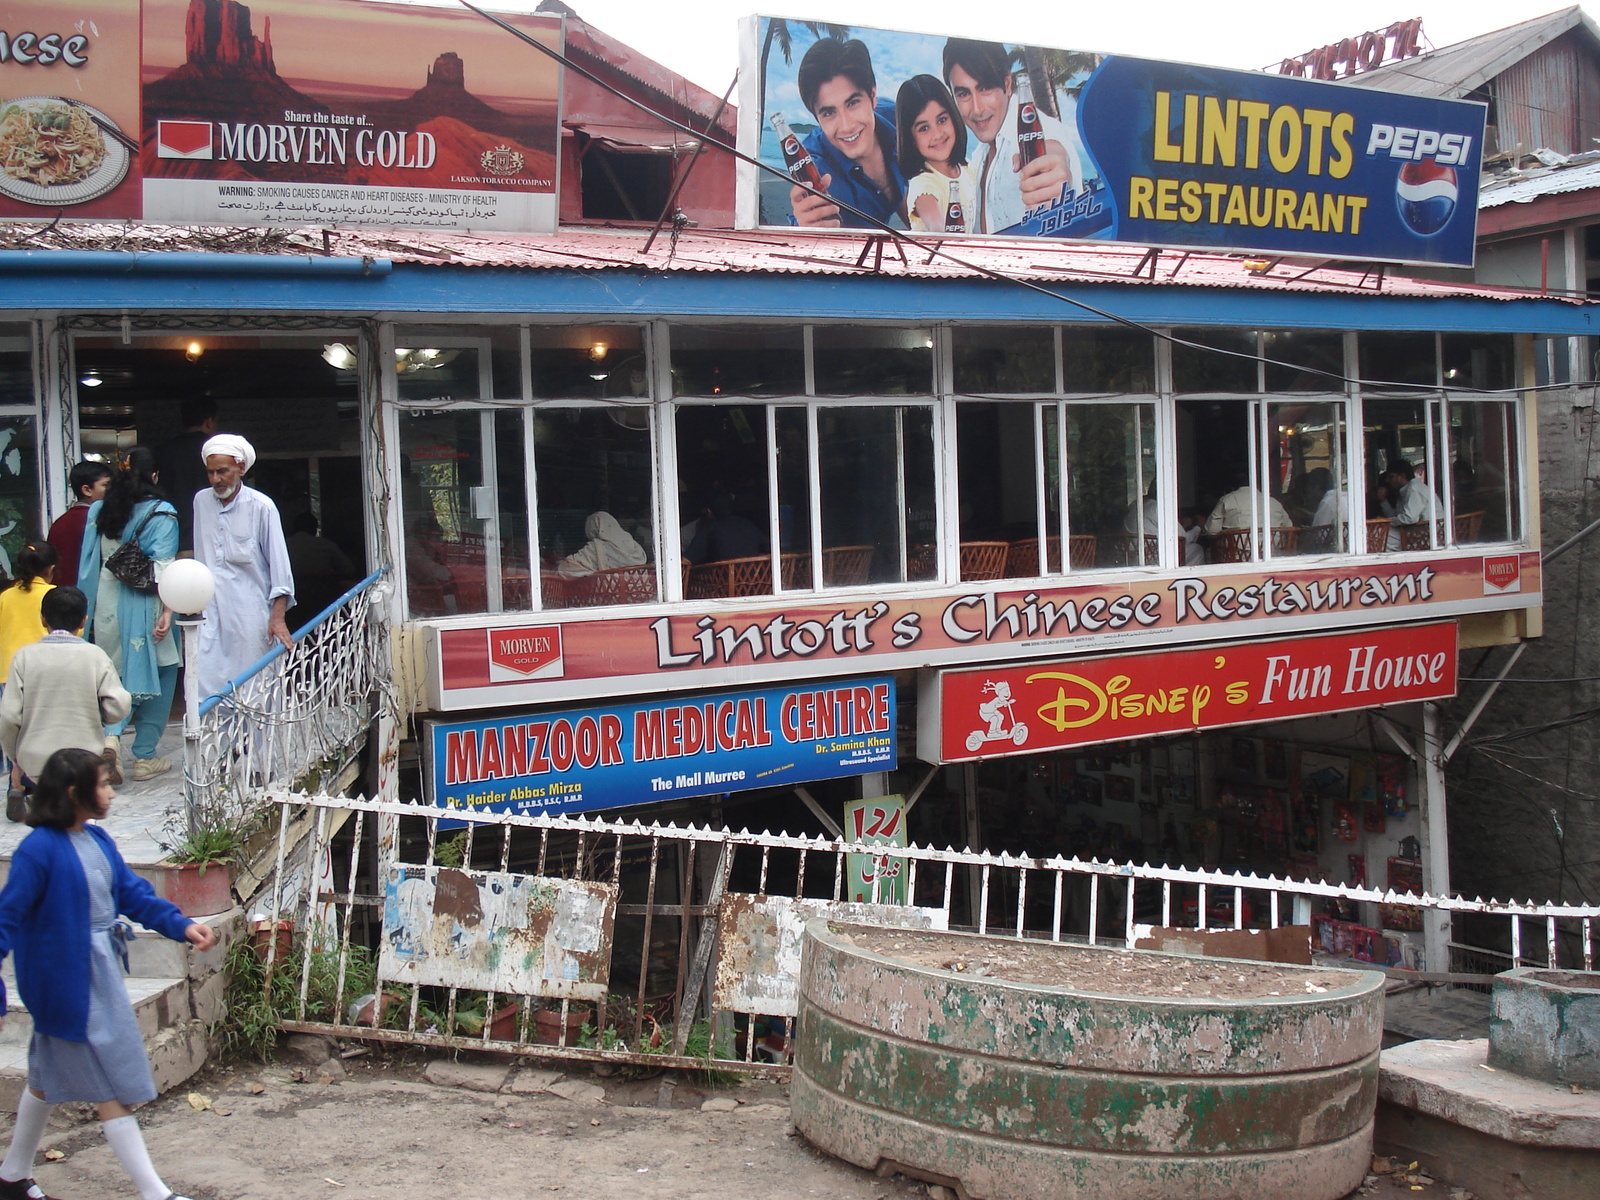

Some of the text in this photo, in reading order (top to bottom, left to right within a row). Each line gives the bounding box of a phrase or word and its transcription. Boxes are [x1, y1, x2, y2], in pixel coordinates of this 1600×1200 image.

[285, 110, 374, 126] Share the taste of...
[218, 122, 436, 169] MORVEN GOLD
[1153, 91, 1354, 180] LINTOTS
[1366, 123, 1473, 166] PEPSI
[450, 175, 552, 187] LAKSON TOBACCO COMPANY
[219, 185, 256, 197] WARNING:
[257, 187, 291, 198] SMOKING
[292, 188, 320, 199] CAUSES
[321, 189, 349, 200] CANCER
[350, 190, 366, 201] AND
[366, 191, 389, 202] HEART
[390, 192, 424, 203] DISEASES
[428, 193, 461, 204] MINISTRY
[462, 195, 471, 205] OF
[472, 195, 497, 206] HEALTH
[1128, 176, 1368, 235] RESTAURANT
[1488, 562, 1515, 576] MORVEN
[650, 565, 1436, 669] Lintott's Chinese Restaurant
[499, 636, 551, 656] MORVEN
[513, 657, 539, 665] GOLD
[1258, 655, 1332, 704] Fun
[1341, 645, 1446, 694] House
[446, 684, 890, 786] MANZOOR MEDICAL CENTRE
[816, 736, 890, 754] Dr. Samina Khan
[651, 777, 672, 791] The
[676, 772, 701, 788] Mall
[704, 770, 746, 784] Murree
[446, 781, 582, 808] Dr. Haider Abbas Mirza
